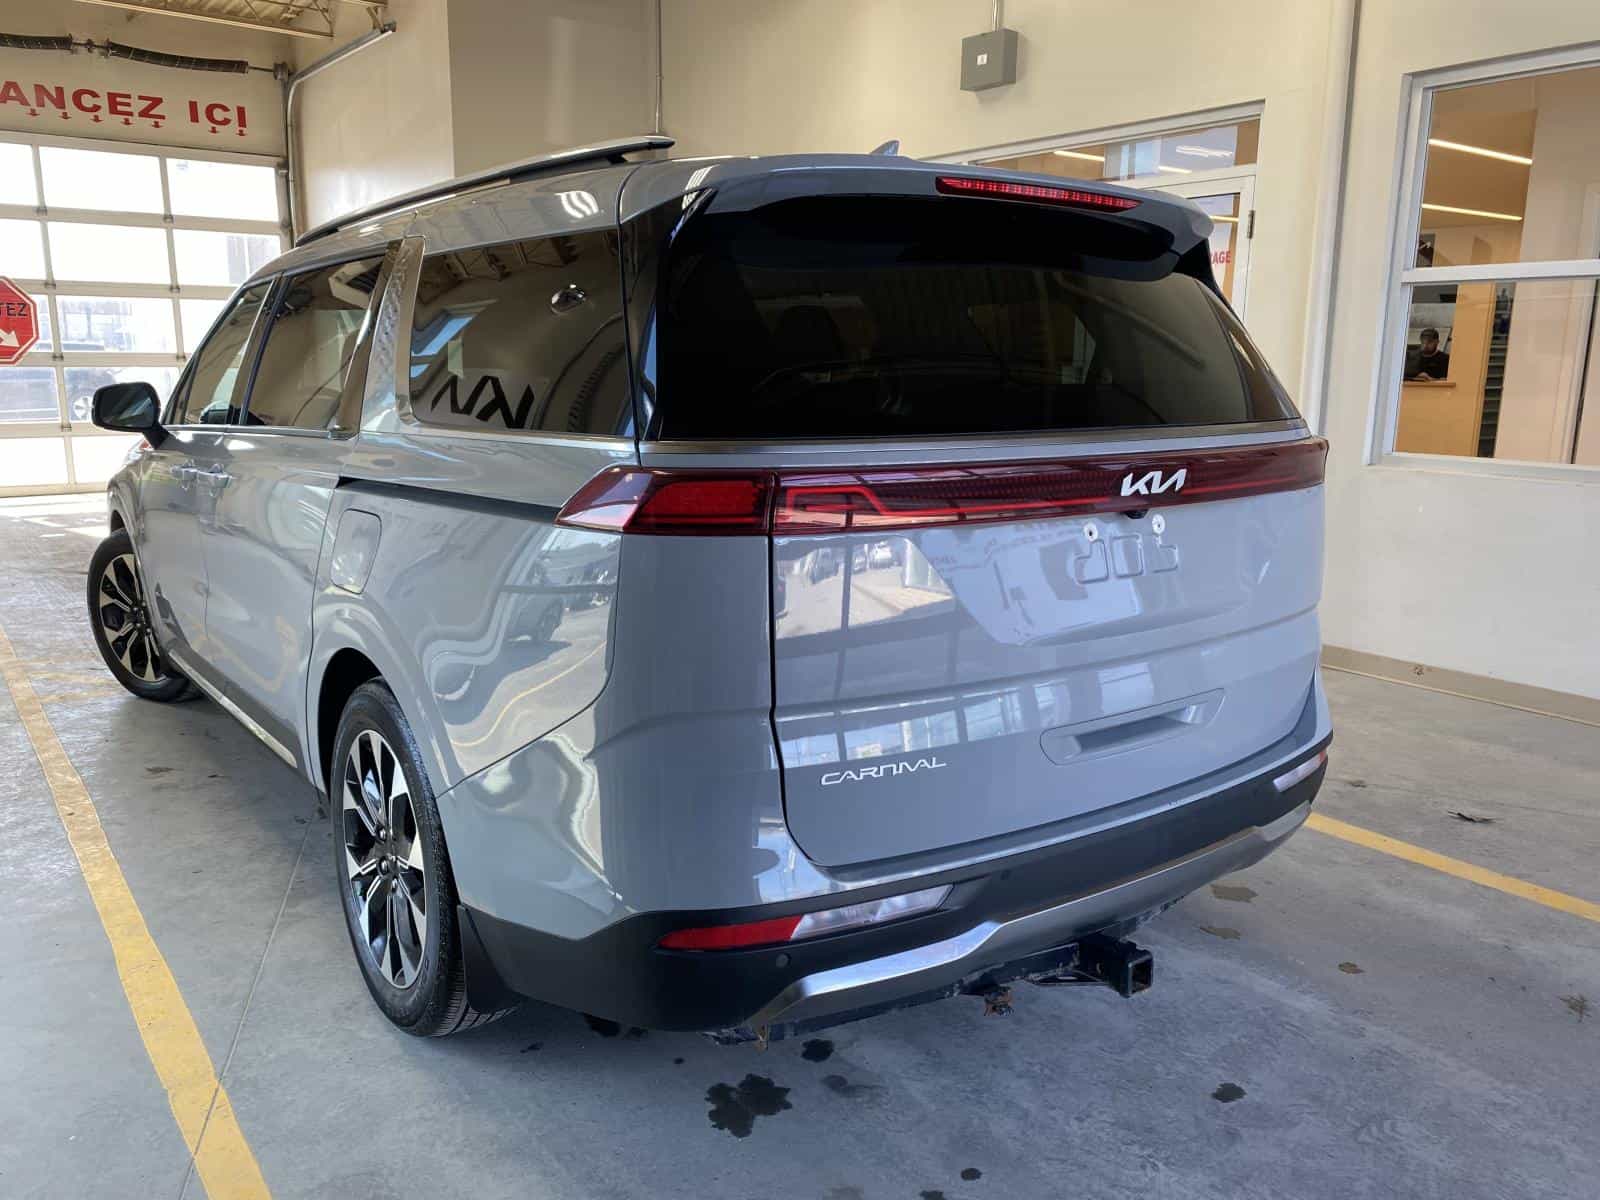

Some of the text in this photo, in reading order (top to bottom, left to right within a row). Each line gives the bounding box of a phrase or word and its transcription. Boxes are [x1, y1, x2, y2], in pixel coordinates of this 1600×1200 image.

[188, 100, 247, 128] ICI
[1121, 468, 1187, 497] KIA
[821, 757, 947, 786] CARNIVAL
